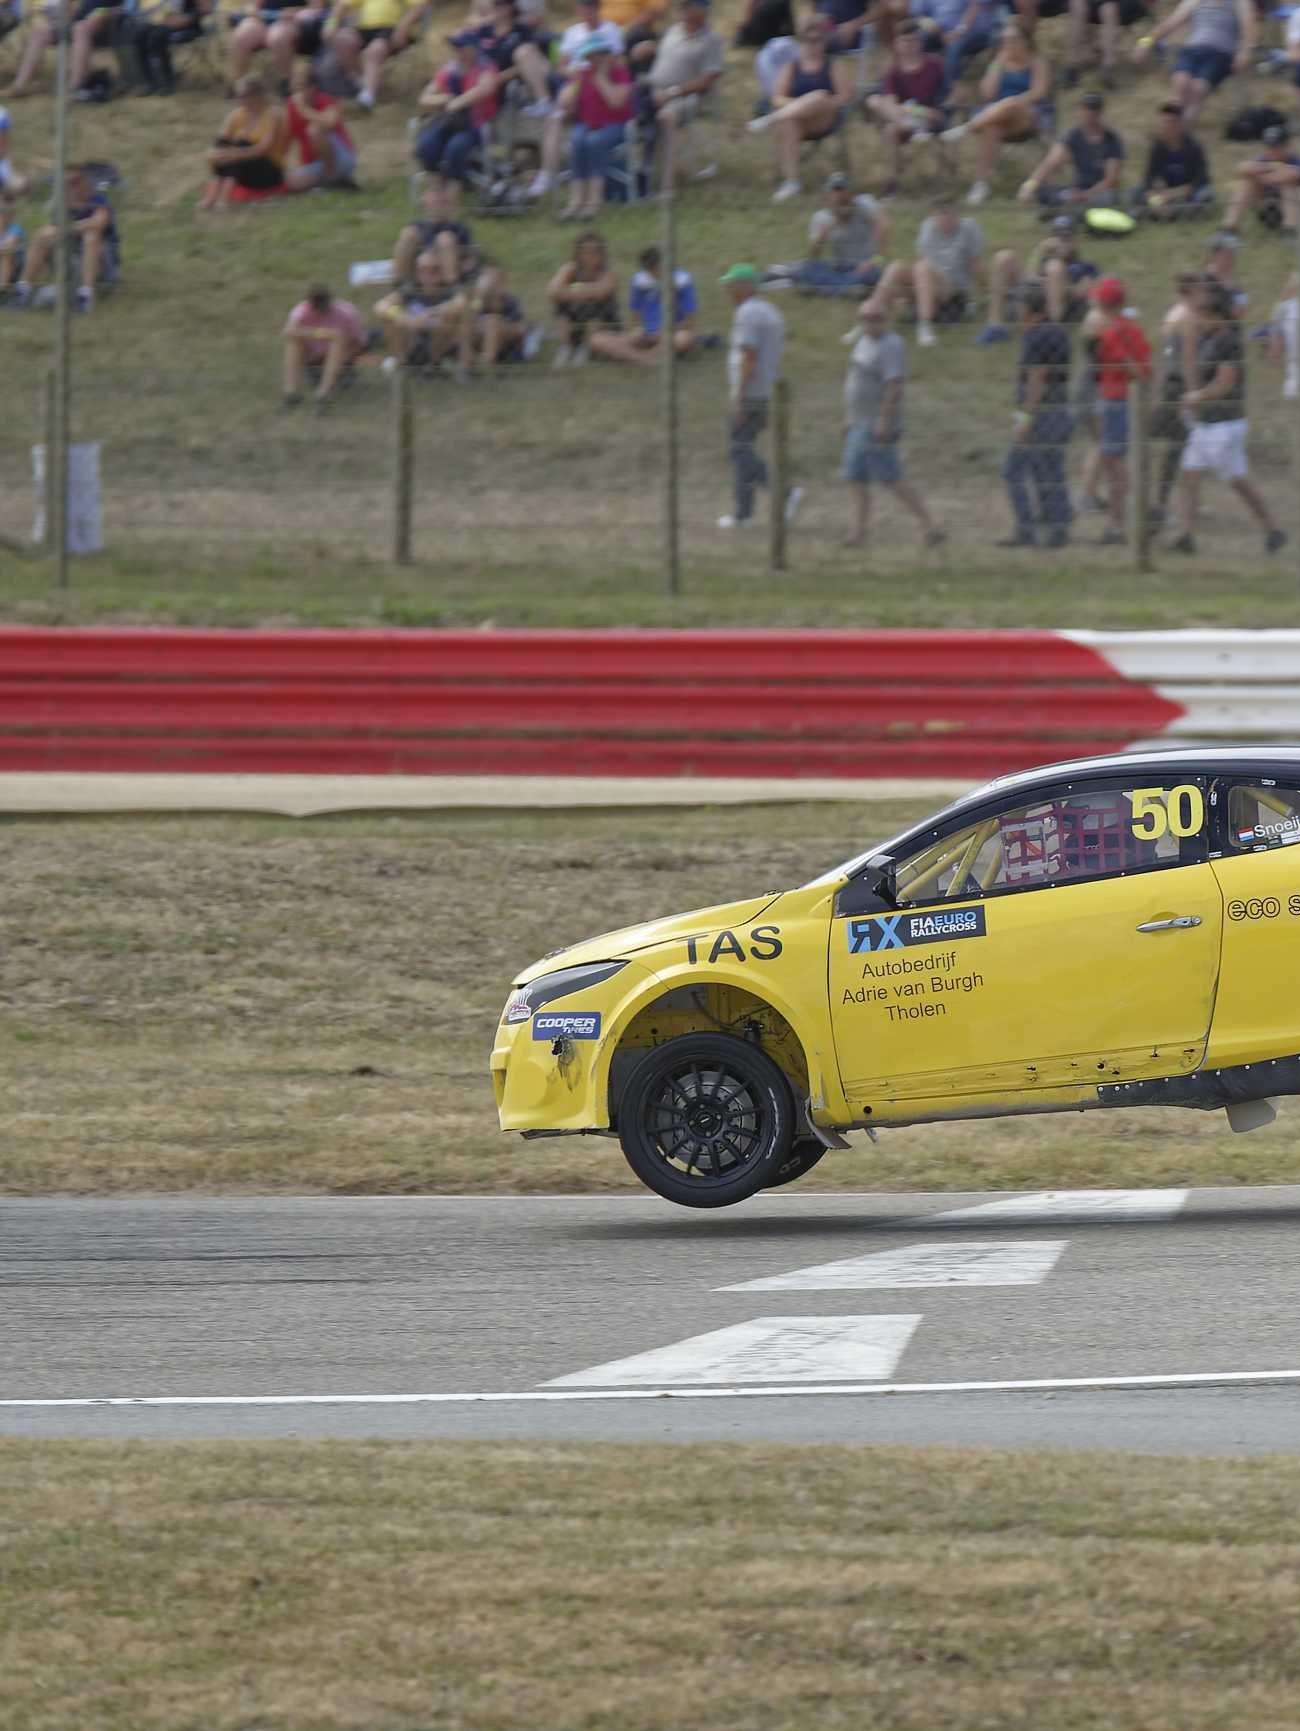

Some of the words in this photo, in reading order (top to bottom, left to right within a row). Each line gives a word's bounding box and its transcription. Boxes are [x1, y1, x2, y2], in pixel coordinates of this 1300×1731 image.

[1131, 784, 1204, 841] 50
[1227, 896, 1281, 921] eco
[910, 921, 977, 938] RALLYCROSS
[676, 925, 783, 965] TAS
[862, 951, 957, 979] Autobedrijf
[842, 987, 888, 1005] Adrie
[893, 981, 925, 998] van
[931, 972, 984, 992] Burgh
[536, 1017, 596, 1028] COOPER
[885, 1002, 946, 1021] Tholen
